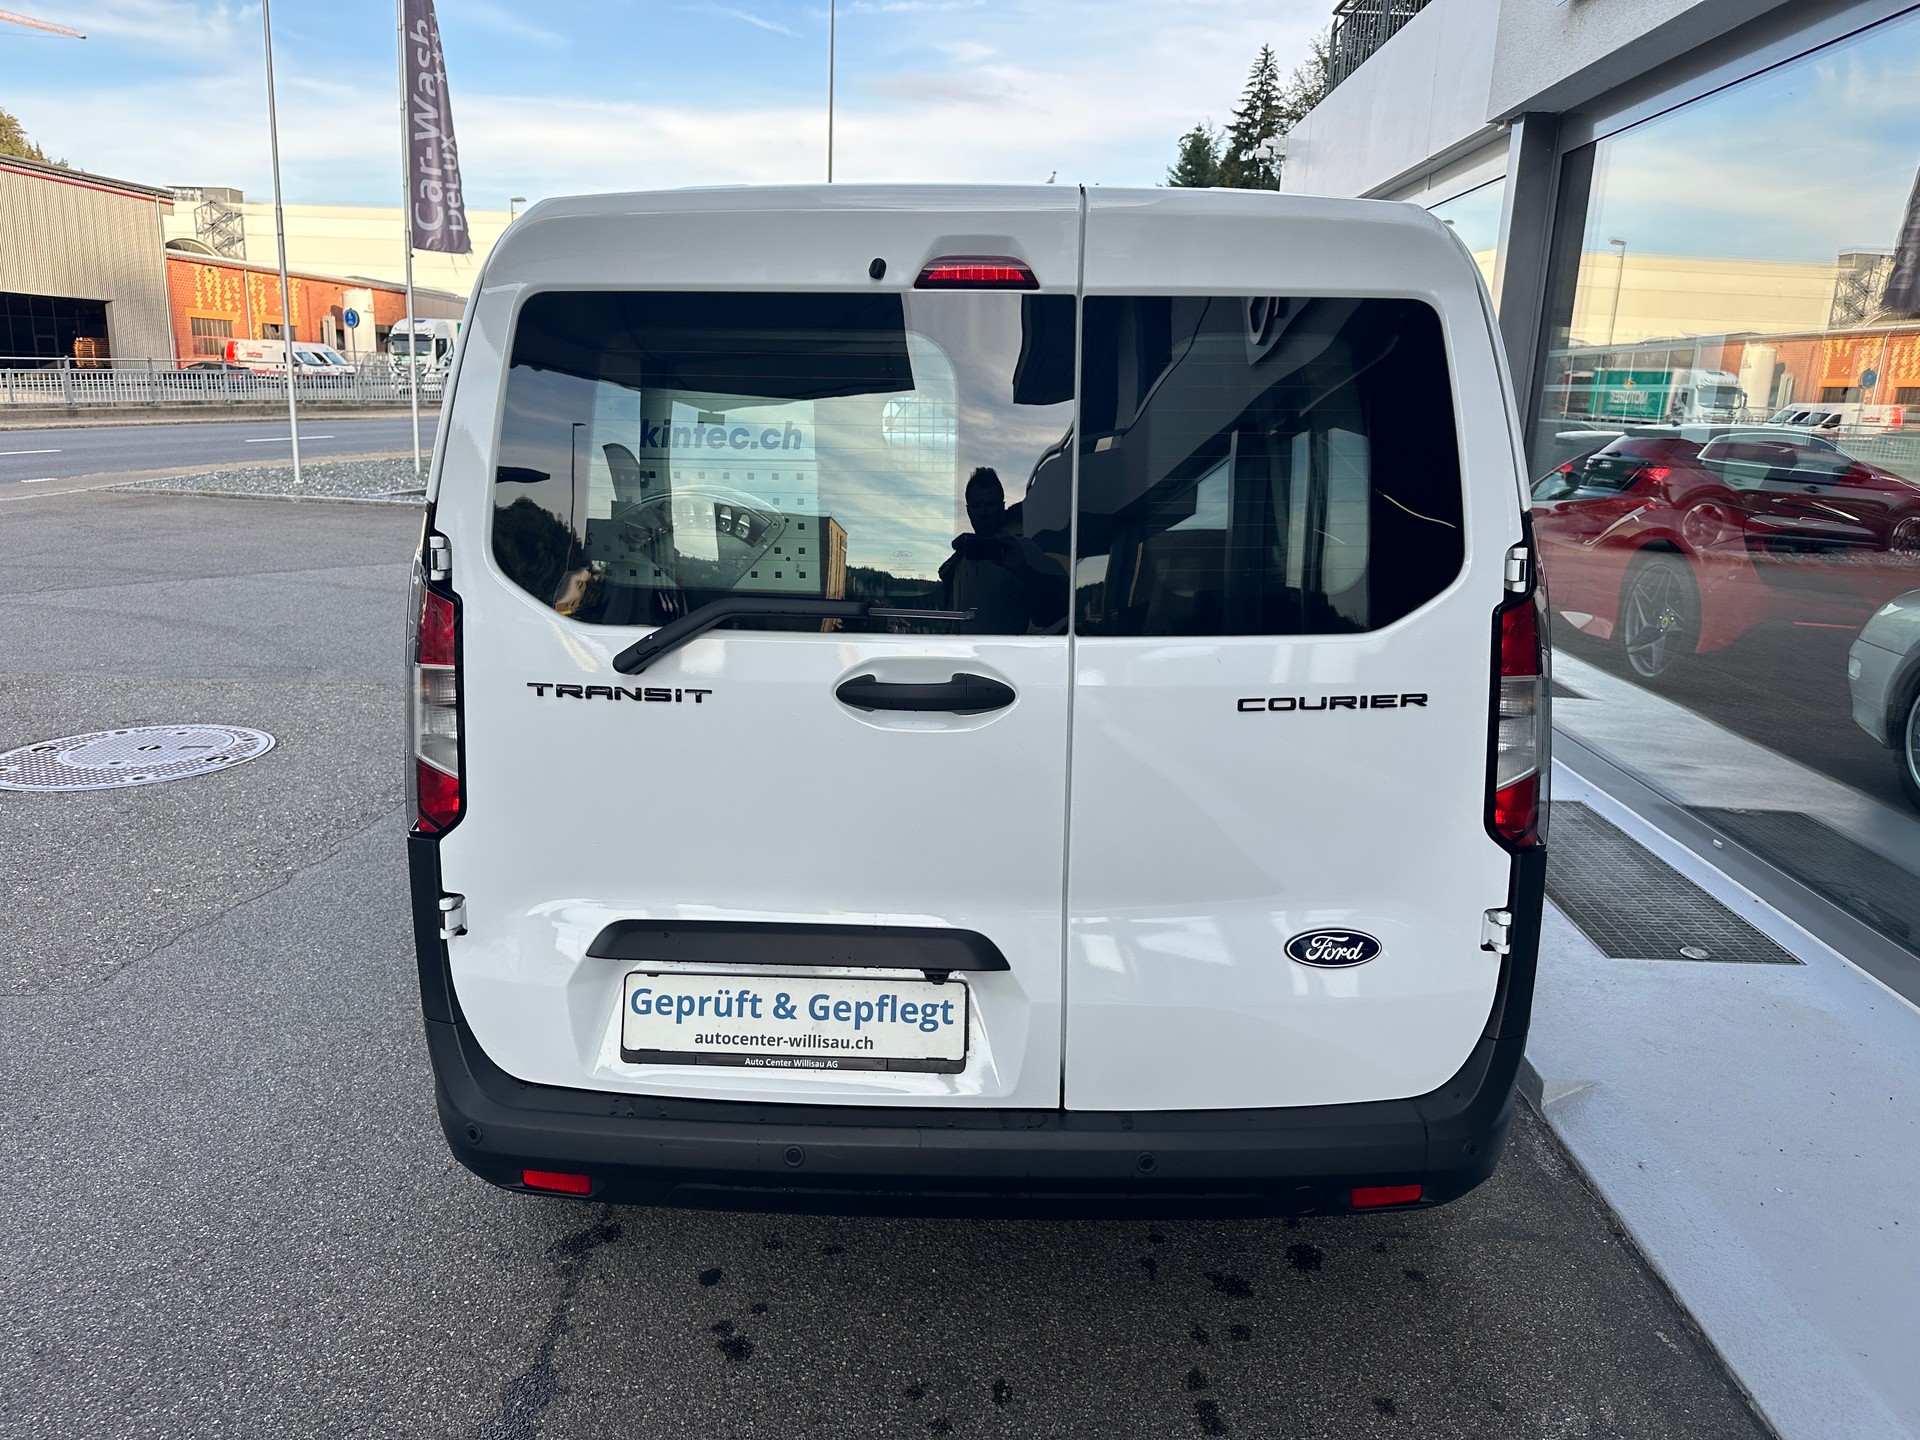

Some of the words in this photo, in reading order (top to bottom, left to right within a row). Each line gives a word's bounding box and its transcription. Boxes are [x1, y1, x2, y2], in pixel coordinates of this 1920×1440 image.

[410, 18, 444, 232] Car-Wash
[640, 418, 802, 450] kintec.ch
[526, 682, 712, 703] TRANSIT
[1237, 693, 1429, 712] COURIER
[1305, 935, 1364, 960] Ford
[630, 988, 762, 1024] Geprüft
[772, 992, 798, 1020] &
[808, 993, 954, 1033] Gepflegt
[694, 1032, 874, 1050] autocenter-willisau.ch
[744, 1057, 764, 1067] Auto
[765, 1058, 792, 1068] Center
[793, 1059, 825, 1069] Willisau
[826, 1061, 839, 1069] AG
